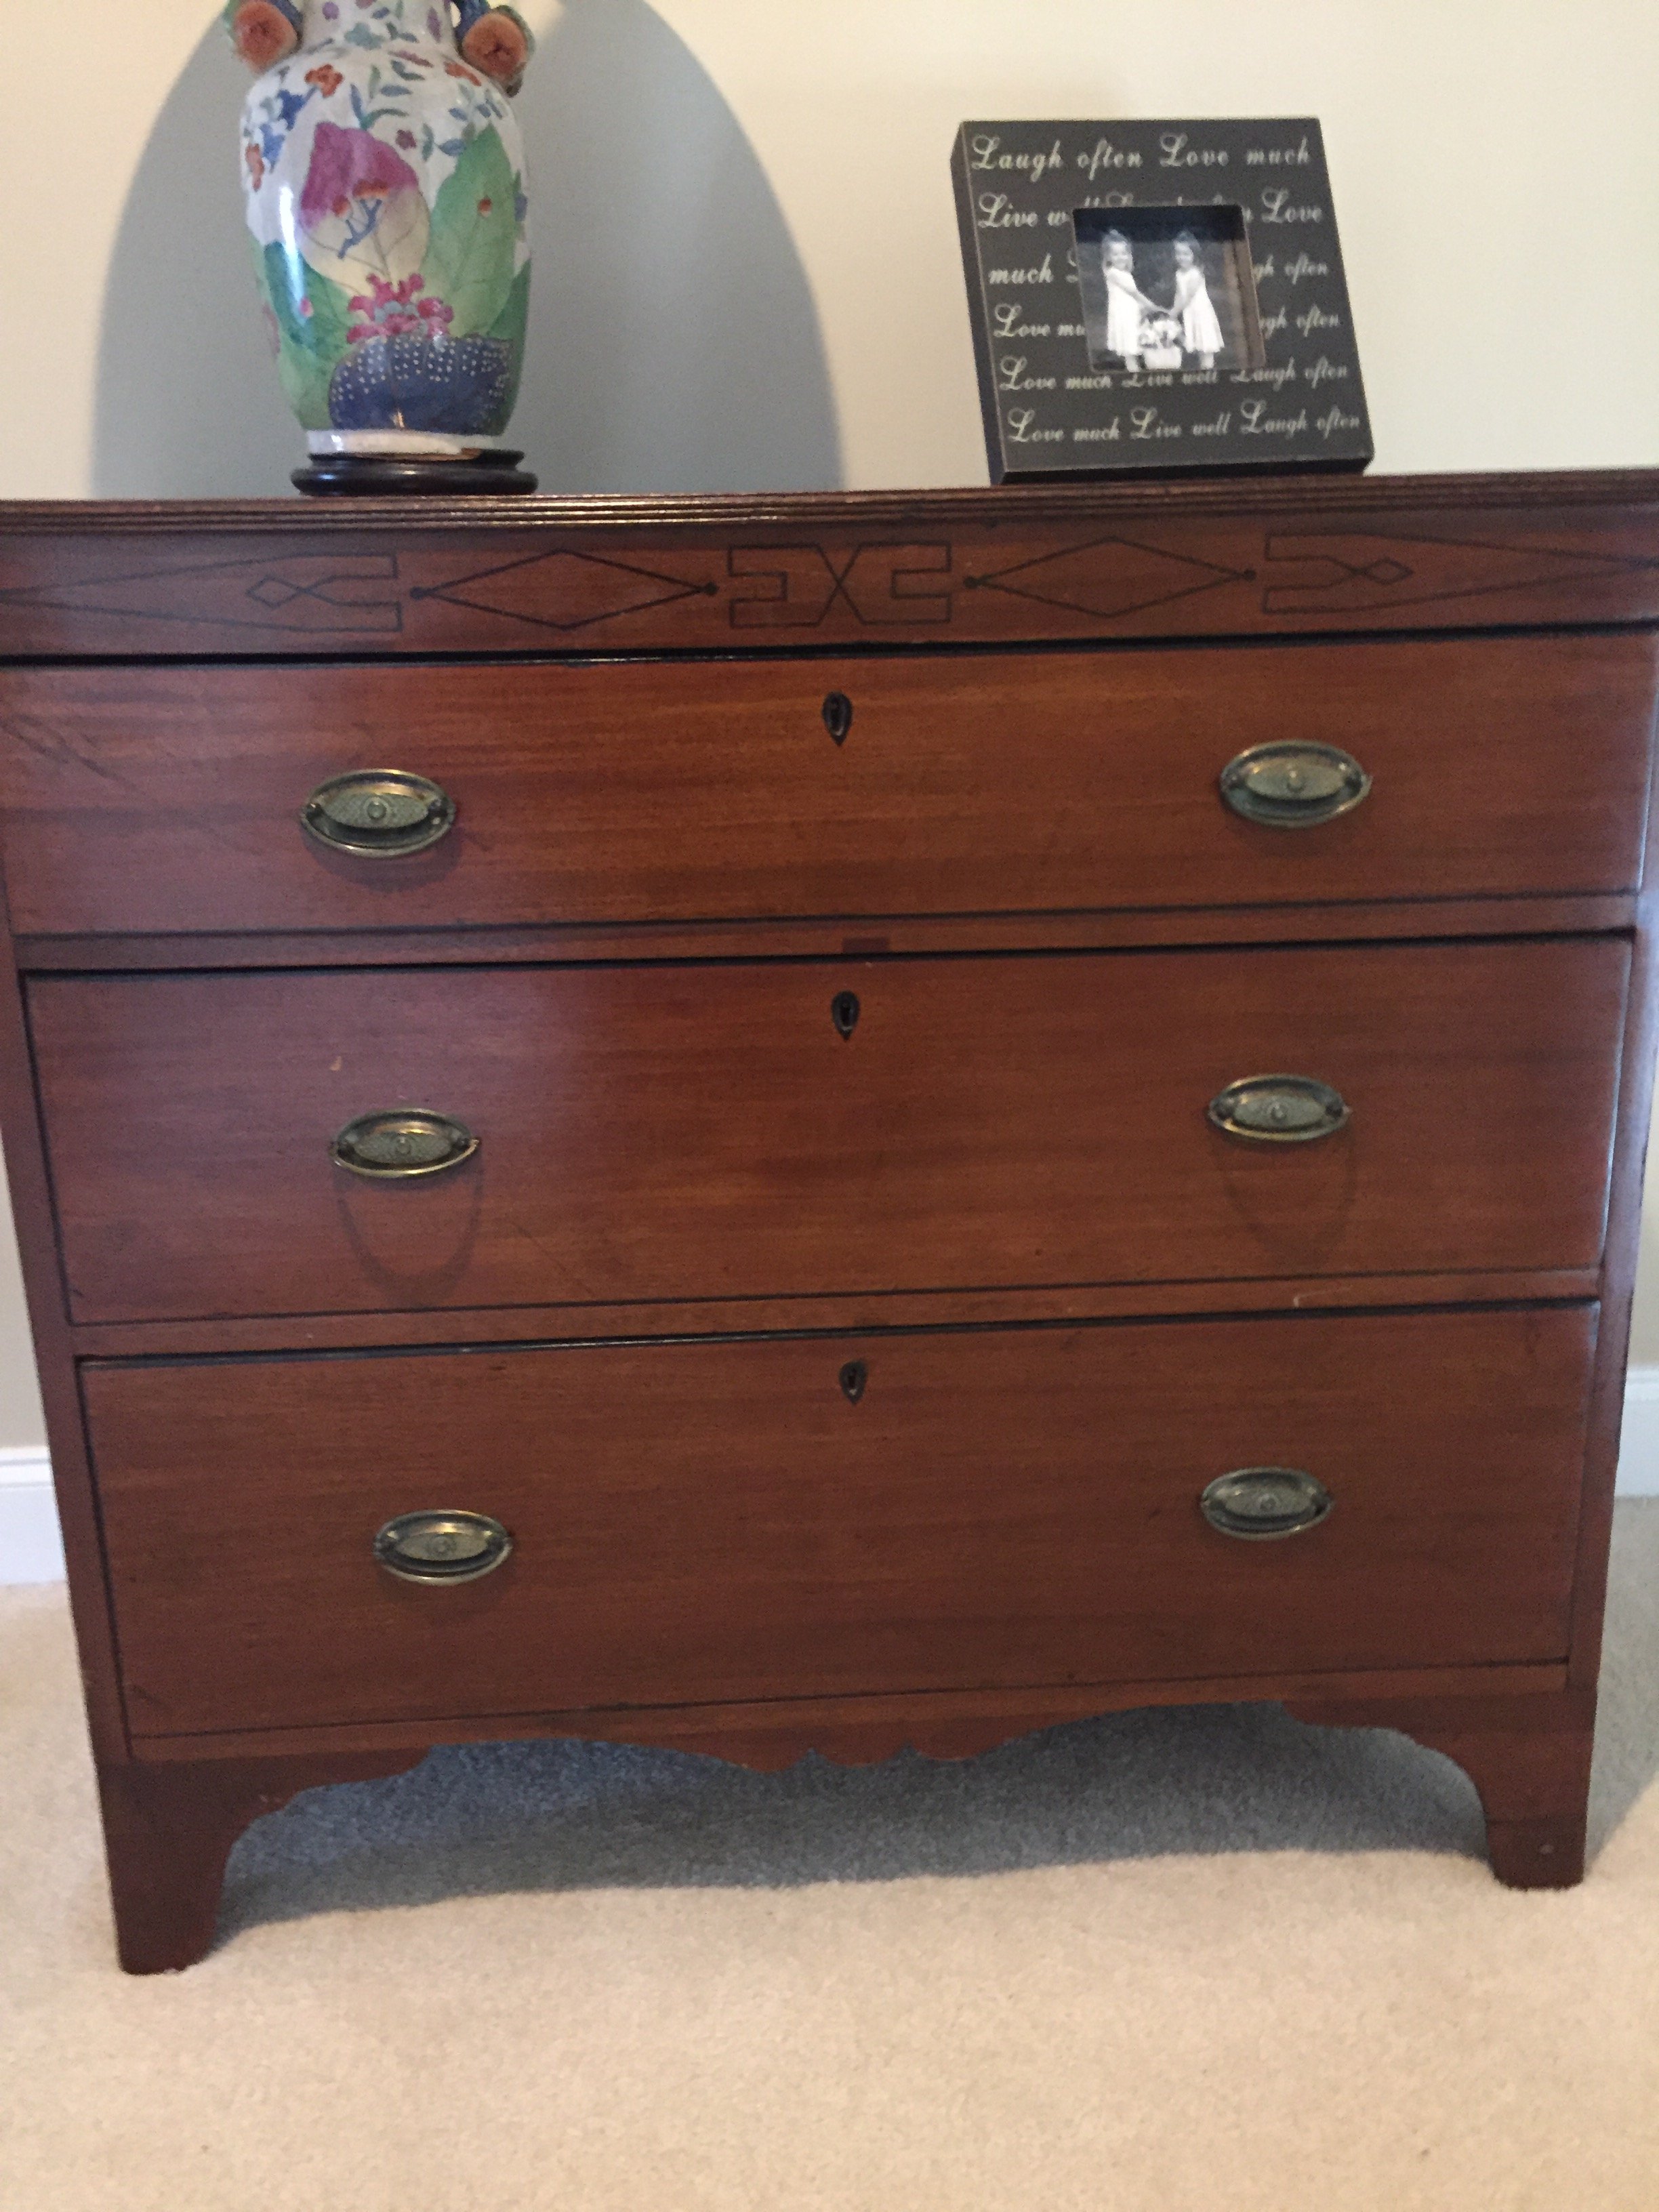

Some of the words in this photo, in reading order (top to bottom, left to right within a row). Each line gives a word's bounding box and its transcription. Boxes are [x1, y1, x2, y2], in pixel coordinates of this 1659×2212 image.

[971, 134, 1063, 183] Laugh
[1078, 138, 1143, 182] often
[1160, 133, 1229, 167] Love
[1246, 135, 1309, 165] much
[978, 192, 1038, 228] Live
[1262, 187, 1322, 223] Love
[988, 253, 1054, 284] much
[1284, 251, 1328, 285] often
[994, 304, 1050, 337] Love
[1296, 304, 1339, 337] often
[1000, 356, 1057, 391] Love
[1305, 356, 1348, 389] often
[1008, 407, 1064, 442] Love
[1073, 417, 1120, 441] much
[1130, 407, 1182, 441] Live
[1193, 412, 1231, 436] well
[1240, 398, 1307, 438] Laugh
[1317, 405, 1360, 439] often
